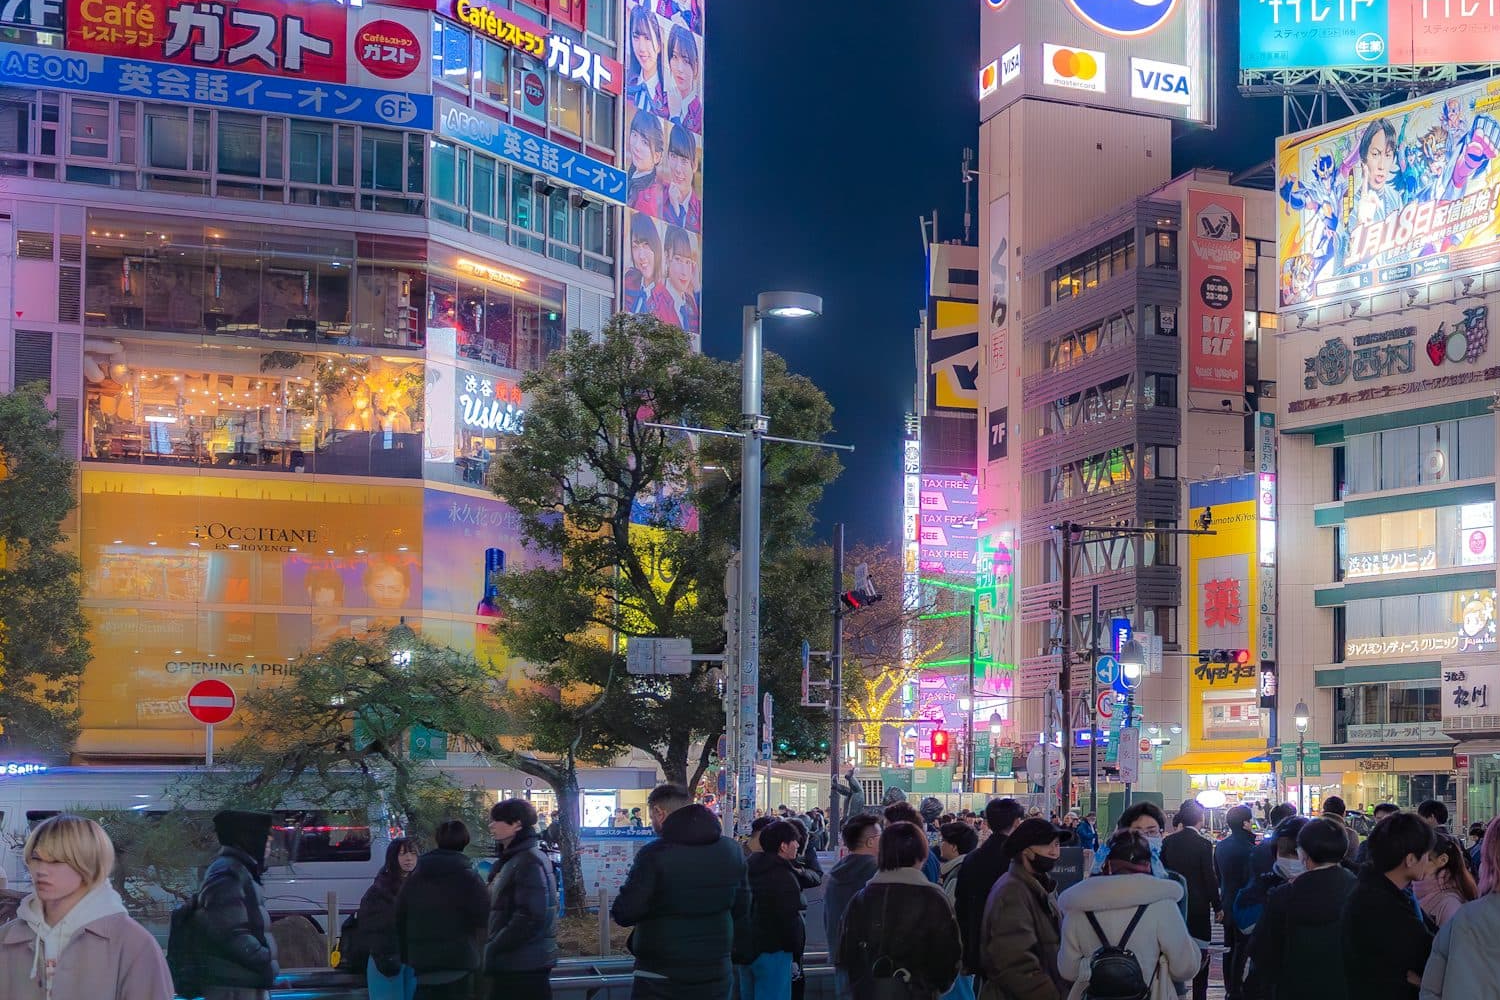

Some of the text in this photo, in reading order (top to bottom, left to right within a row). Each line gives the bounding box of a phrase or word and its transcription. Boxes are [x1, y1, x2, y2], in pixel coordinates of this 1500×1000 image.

[82, 26, 154, 48] レストラン
[164, 1, 333, 71] ガスト
[363, 44, 415, 64] ガスト
[547, 34, 613, 90] ガスト
[5, 53, 89, 83] AEON
[1003, 55, 1020, 76] VISA
[118, 62, 413, 121] 英会話イーオン 6F
[1053, 77, 1096, 90] mastercard
[1136, 68, 1190, 95] VISA
[503, 128, 624, 195] 英会話イーオン
[1202, 315, 1233, 335] B1F
[1201, 336, 1233, 357] B2F
[991, 422, 1006, 446] 7F
[922, 479, 970, 490] TAX FREE
[920, 497, 938, 505] REE
[922, 514, 942, 523] TAX
[920, 532, 938, 540] REE
[237, 544, 293, 553] ROVENCE
[922, 549, 970, 560] TAX FREE
[1204, 578, 1241, 628] 薬
[165, 661, 244, 677] OPENING
